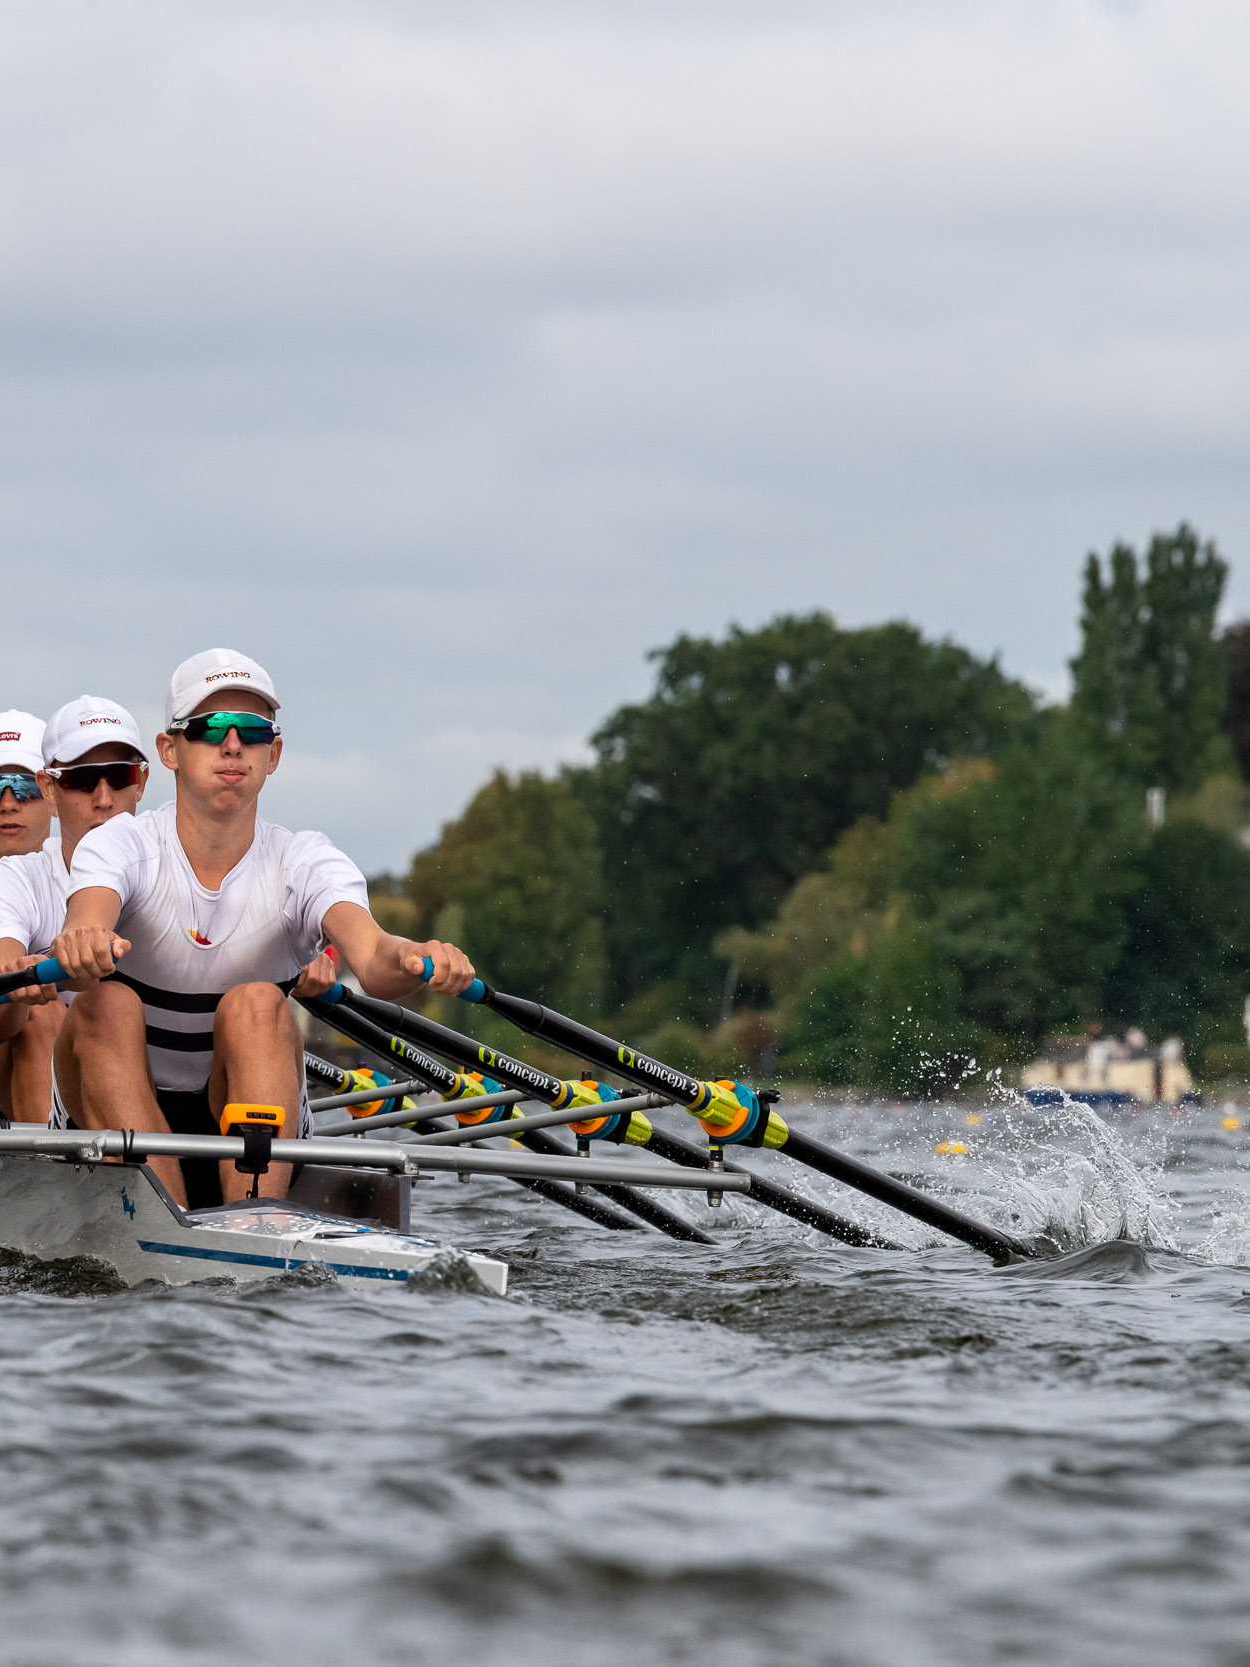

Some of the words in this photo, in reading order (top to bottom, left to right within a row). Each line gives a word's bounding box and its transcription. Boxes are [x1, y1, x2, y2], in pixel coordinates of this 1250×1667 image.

[205, 671, 251, 684] ROWING
[79, 717, 121, 727] ROWING
[304, 1055, 335, 1077] ncept
[336, 1070, 344, 1082] 2
[406, 1048, 447, 1080] concept
[447, 1073, 455, 1085] 2
[498, 1057, 549, 1089] concept
[551, 1081, 560, 1095] 2
[637, 1058, 688, 1091] concept
[689, 1082, 698, 1096] 2
